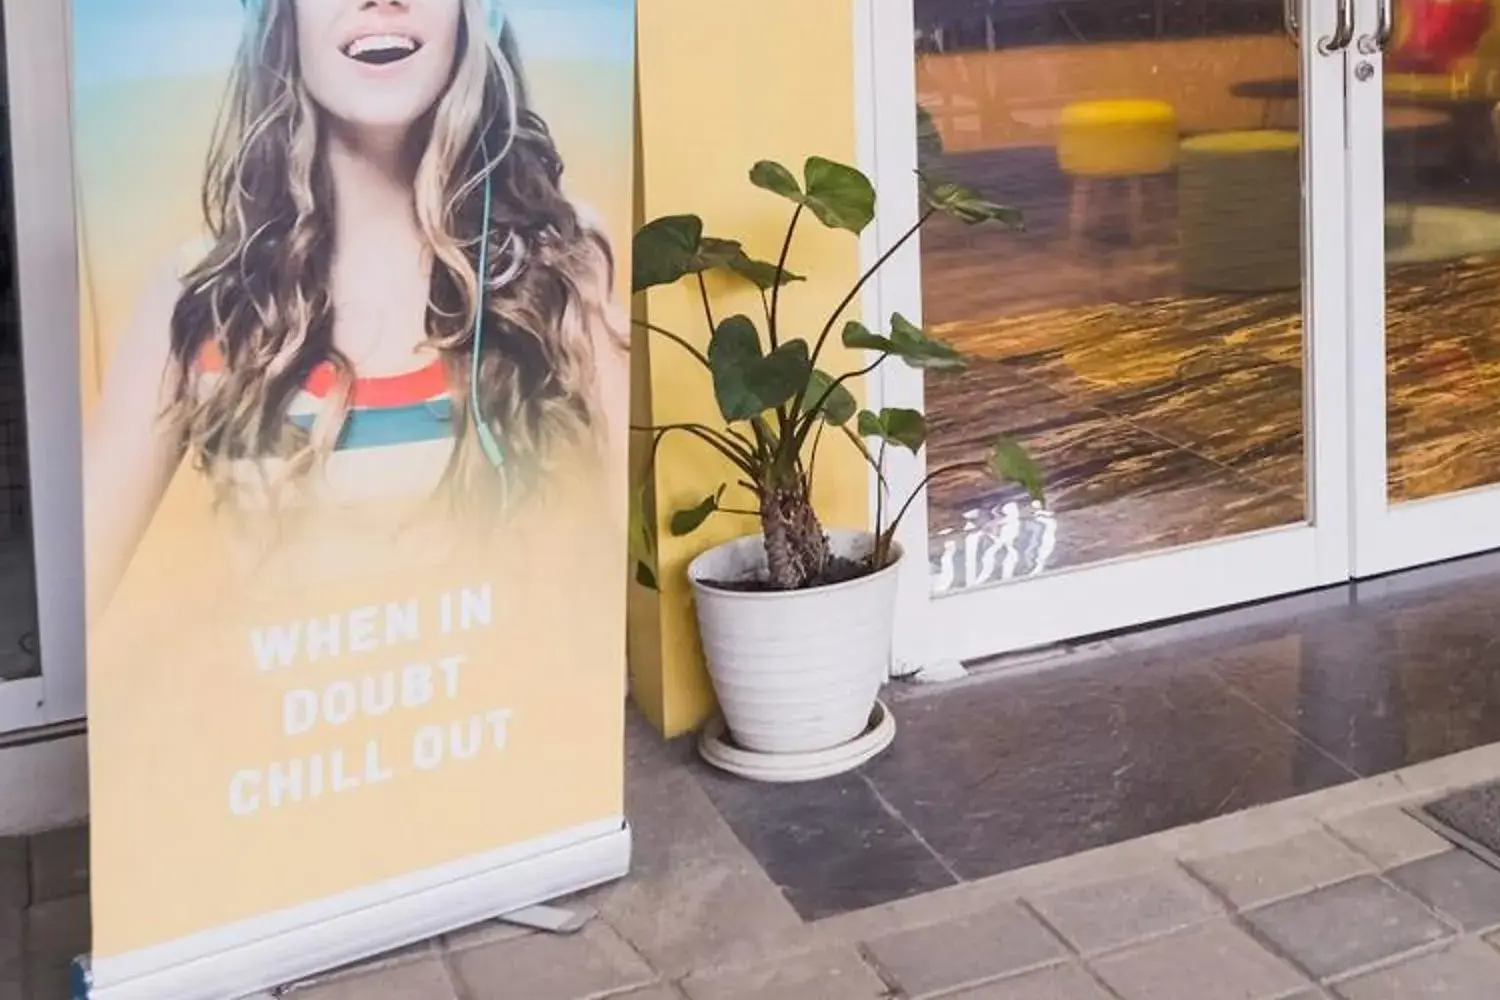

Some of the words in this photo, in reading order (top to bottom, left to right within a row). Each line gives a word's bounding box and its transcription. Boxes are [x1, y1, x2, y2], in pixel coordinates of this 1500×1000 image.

[250, 598, 420, 671] WHEN
[439, 581, 492, 634] IN
[282, 653, 467, 736] DOUBT
[227, 738, 394, 816] CHILL
[411, 707, 514, 771] OUT
